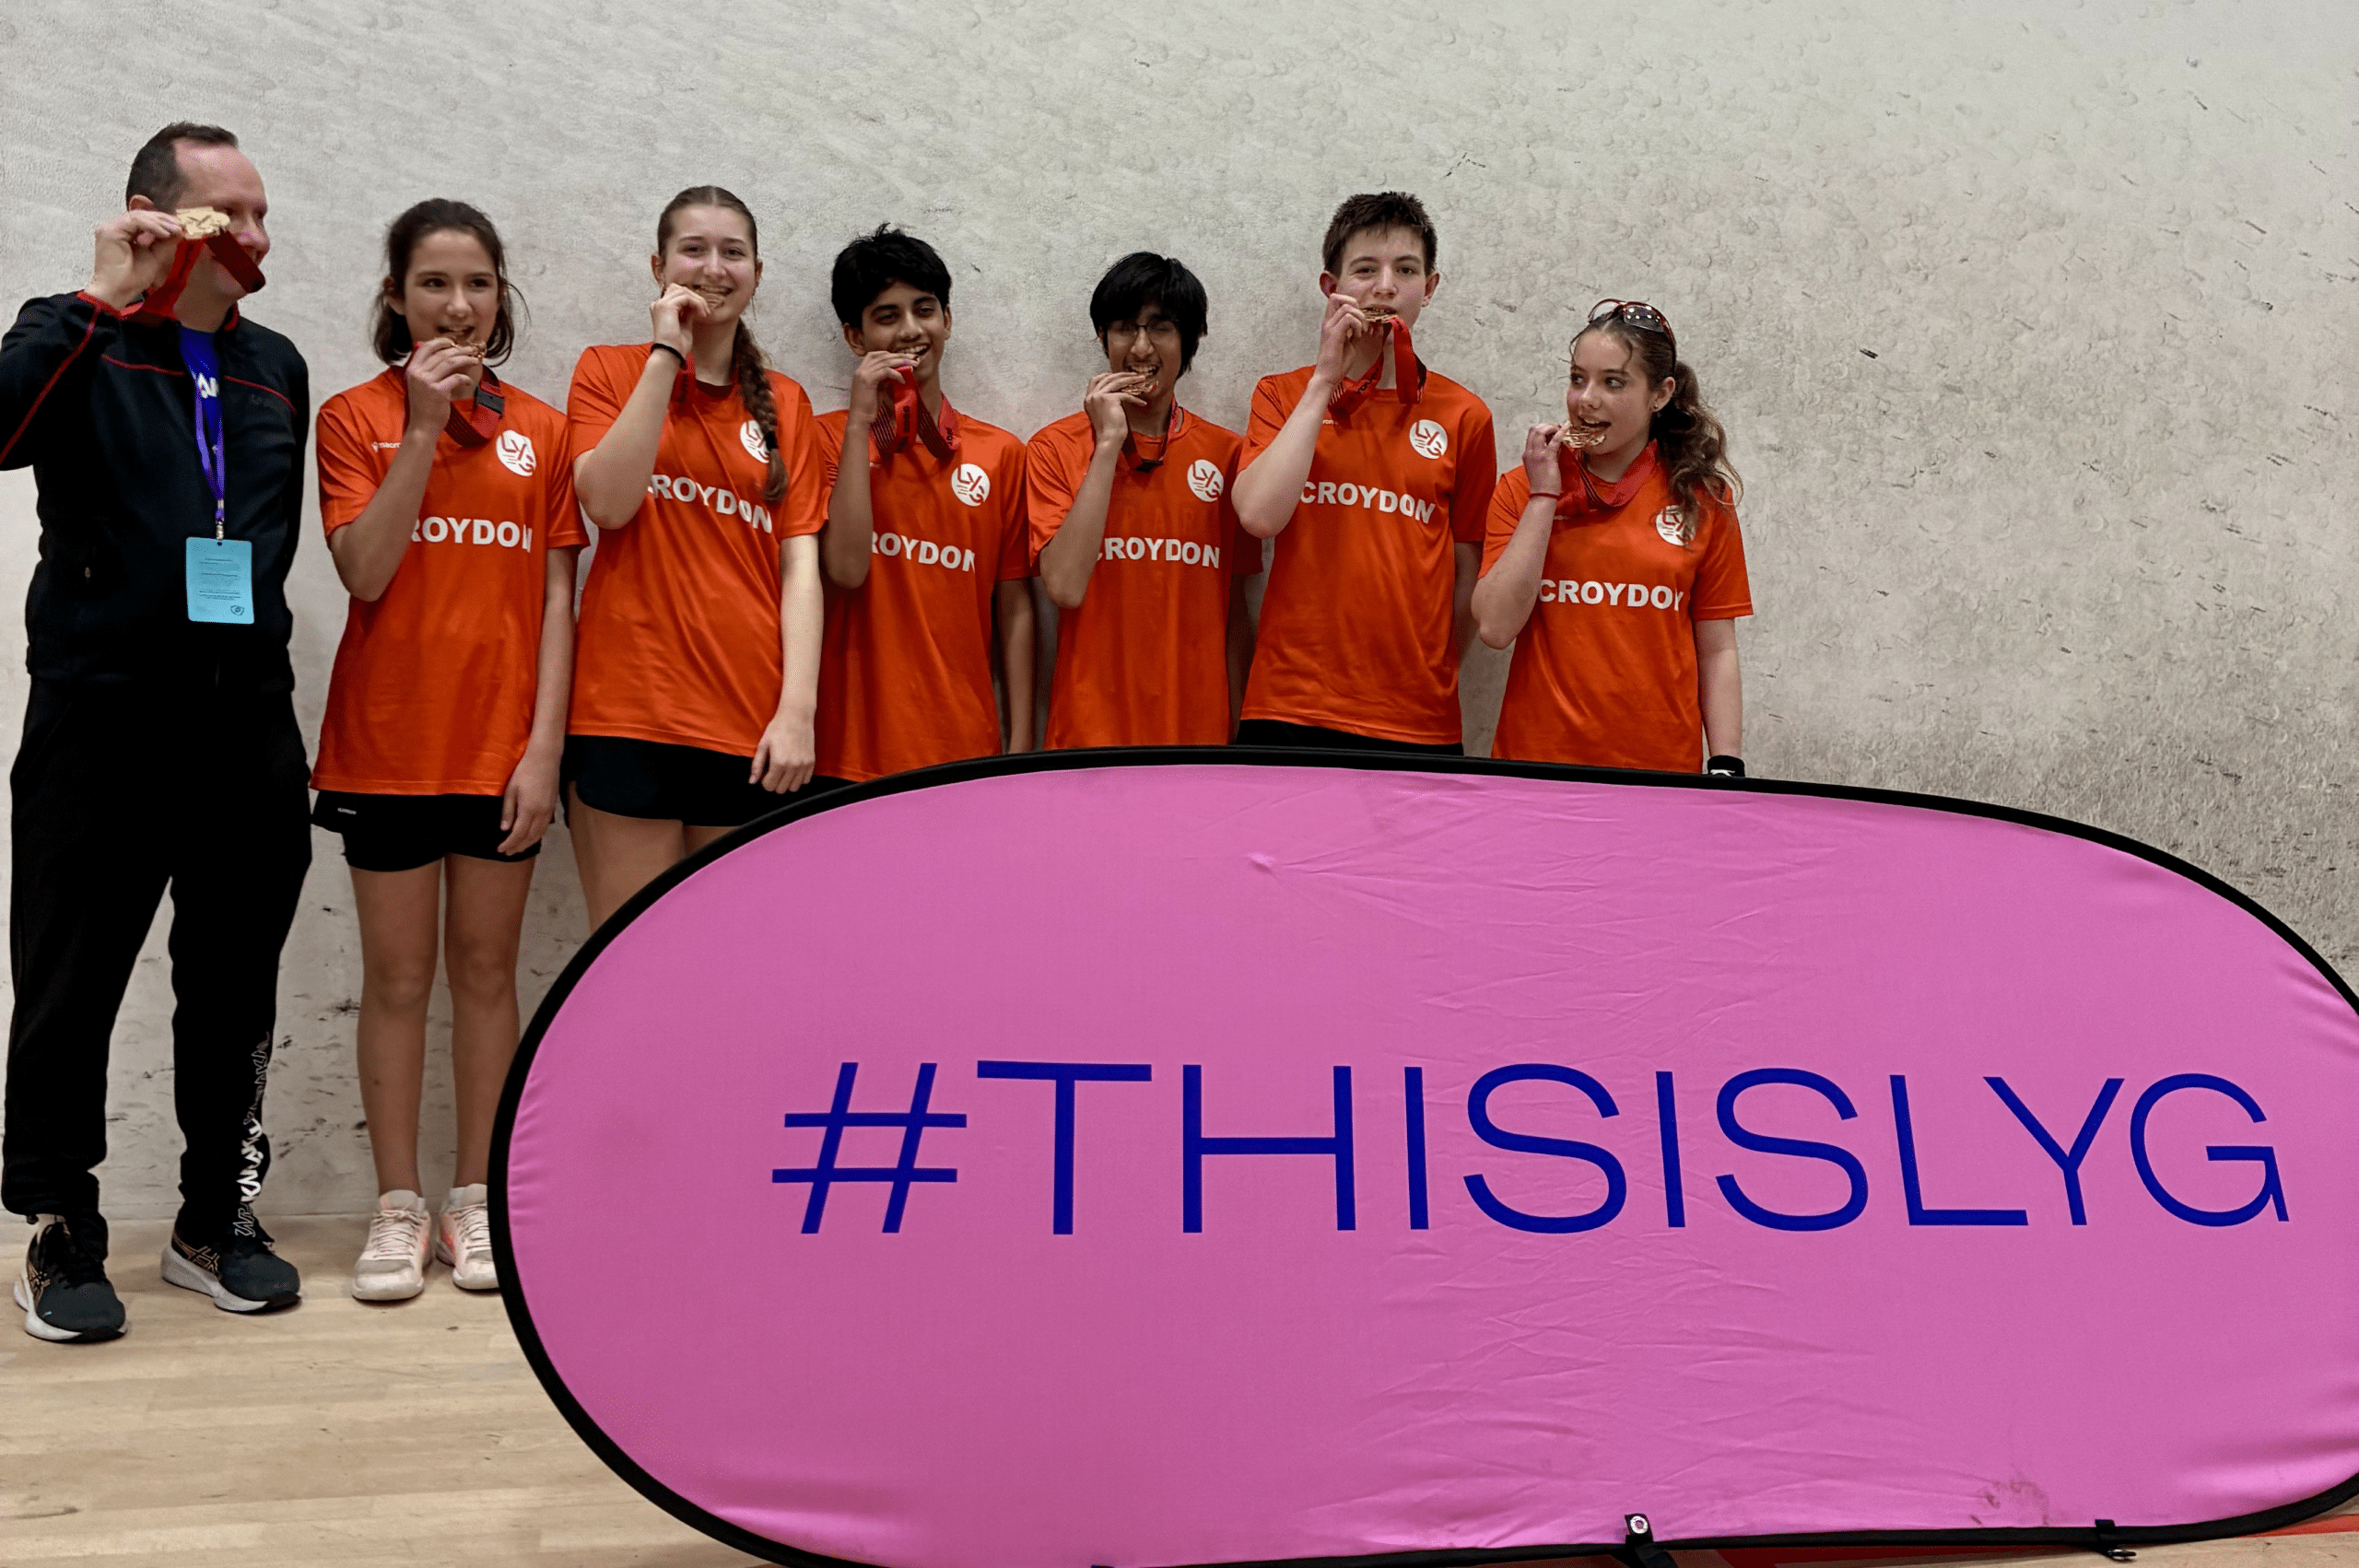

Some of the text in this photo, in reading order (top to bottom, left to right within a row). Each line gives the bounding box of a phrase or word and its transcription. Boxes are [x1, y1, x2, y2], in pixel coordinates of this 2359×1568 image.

[648, 474, 772, 533] ROYDON
[1301, 481, 1436, 524] CROYDON
[412, 516, 533, 553] OYDON
[872, 531, 976, 573] OYDON
[1097, 536, 1220, 568] ROYDON
[772, 1060, 2289, 1235] #THISISLYG
